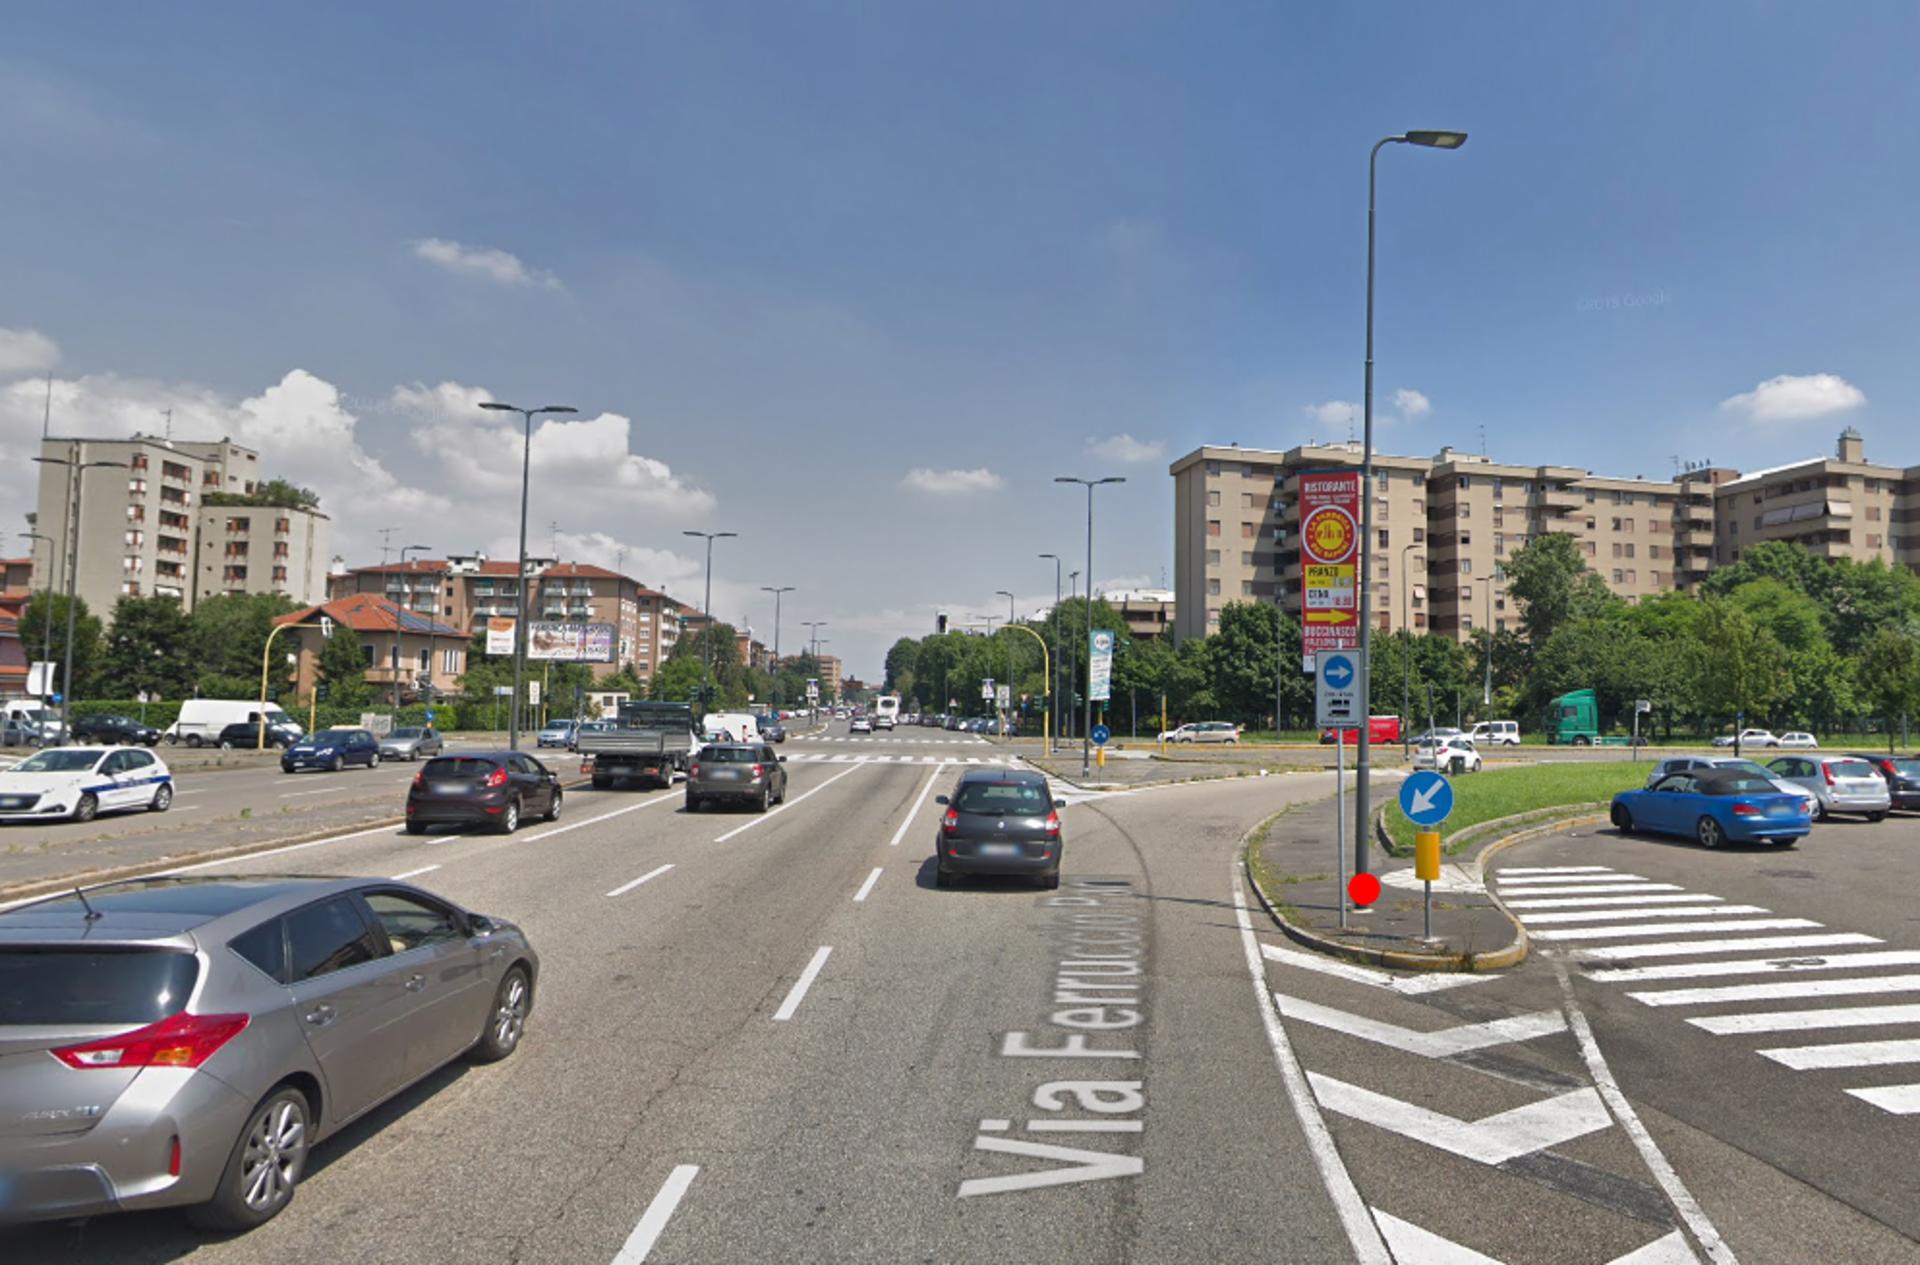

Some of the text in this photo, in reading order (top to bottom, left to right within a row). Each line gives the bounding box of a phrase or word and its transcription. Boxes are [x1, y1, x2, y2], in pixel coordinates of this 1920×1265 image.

[1304, 480, 1356, 493] RISTORANTE
[1308, 566, 1339, 576] PRANZO
[1308, 589, 1329, 598] CENA
